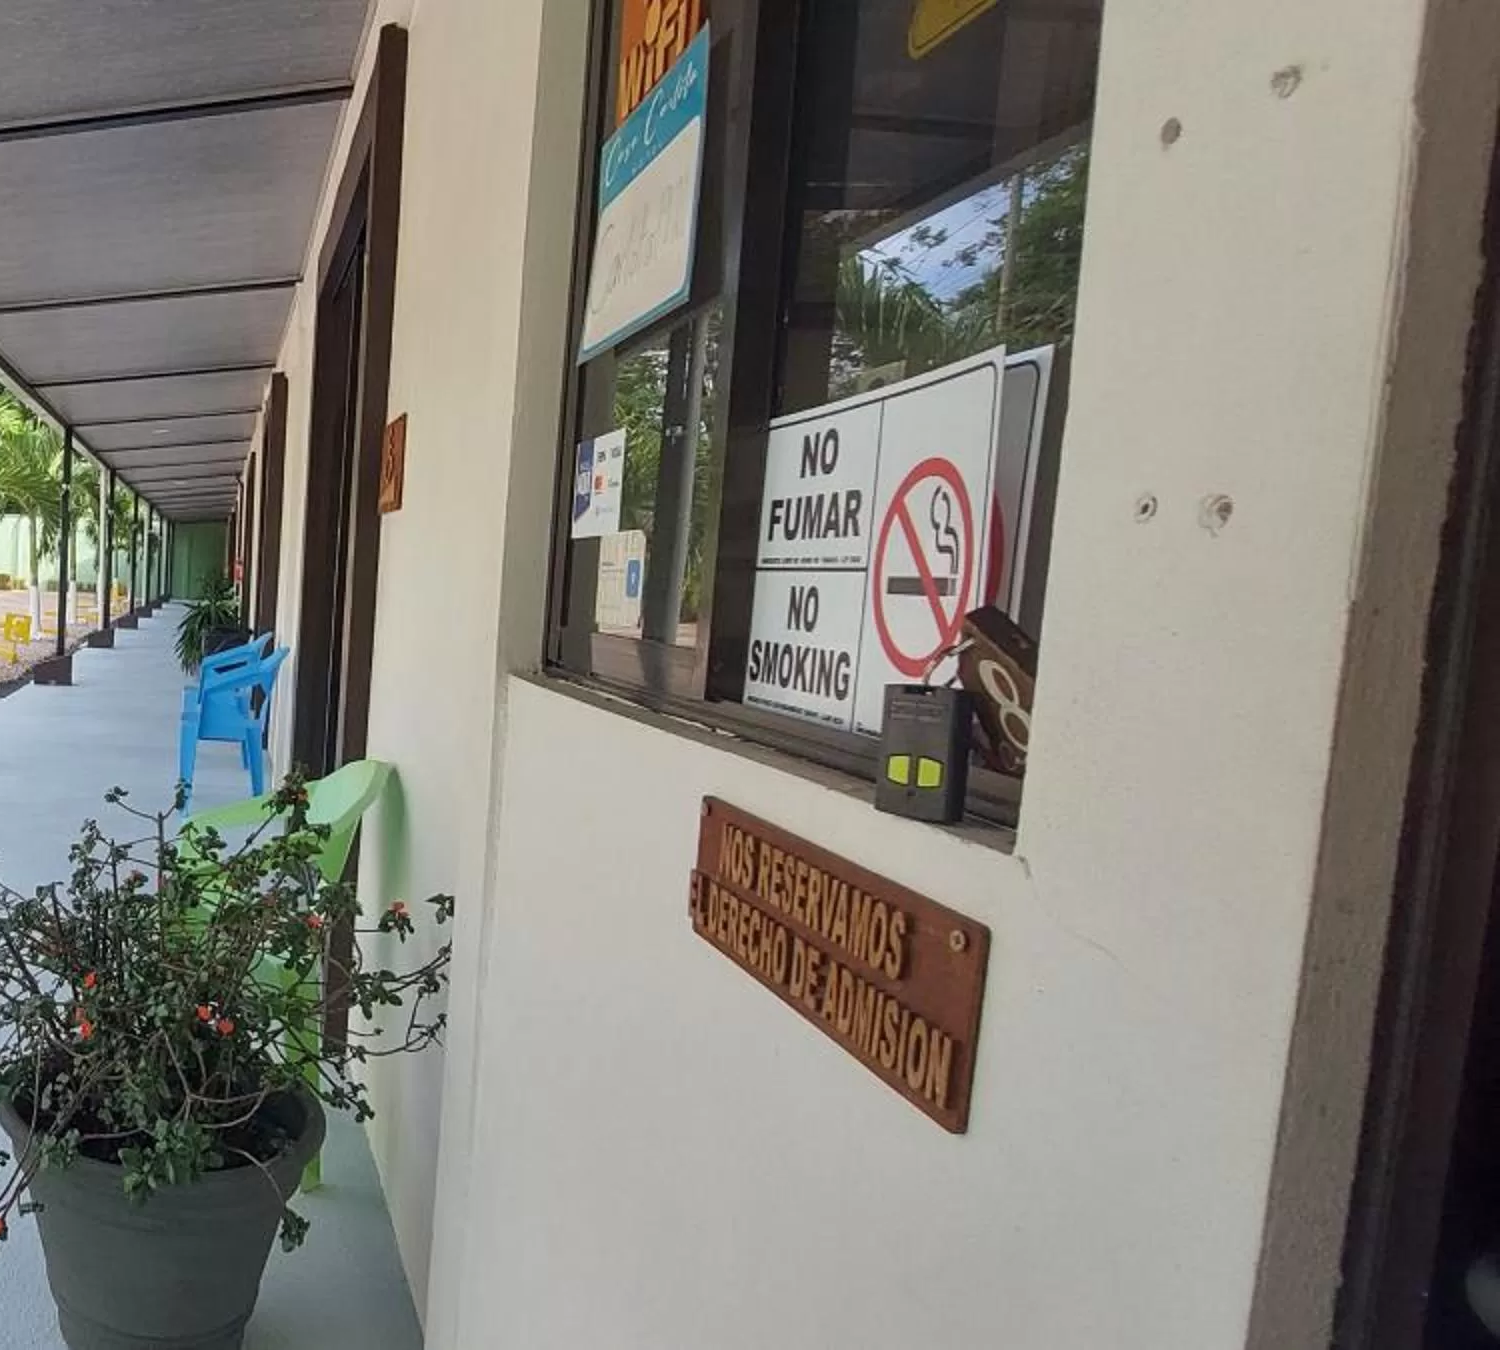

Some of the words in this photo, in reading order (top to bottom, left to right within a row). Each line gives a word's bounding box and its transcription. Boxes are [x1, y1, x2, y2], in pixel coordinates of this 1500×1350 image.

[800, 428, 839, 479] NO
[767, 489, 862, 542] FUMAR
[787, 585, 819, 632] NO
[749, 639, 850, 701] SMOKING
[979, 659, 1032, 752] 8
[719, 823, 754, 889] NOS
[756, 842, 906, 980] RESERVAMOS
[690, 869, 706, 927] EL
[707, 880, 788, 986] DERECHO
[788, 935, 823, 1012] DE
[821, 960, 953, 1110] ADMISION
